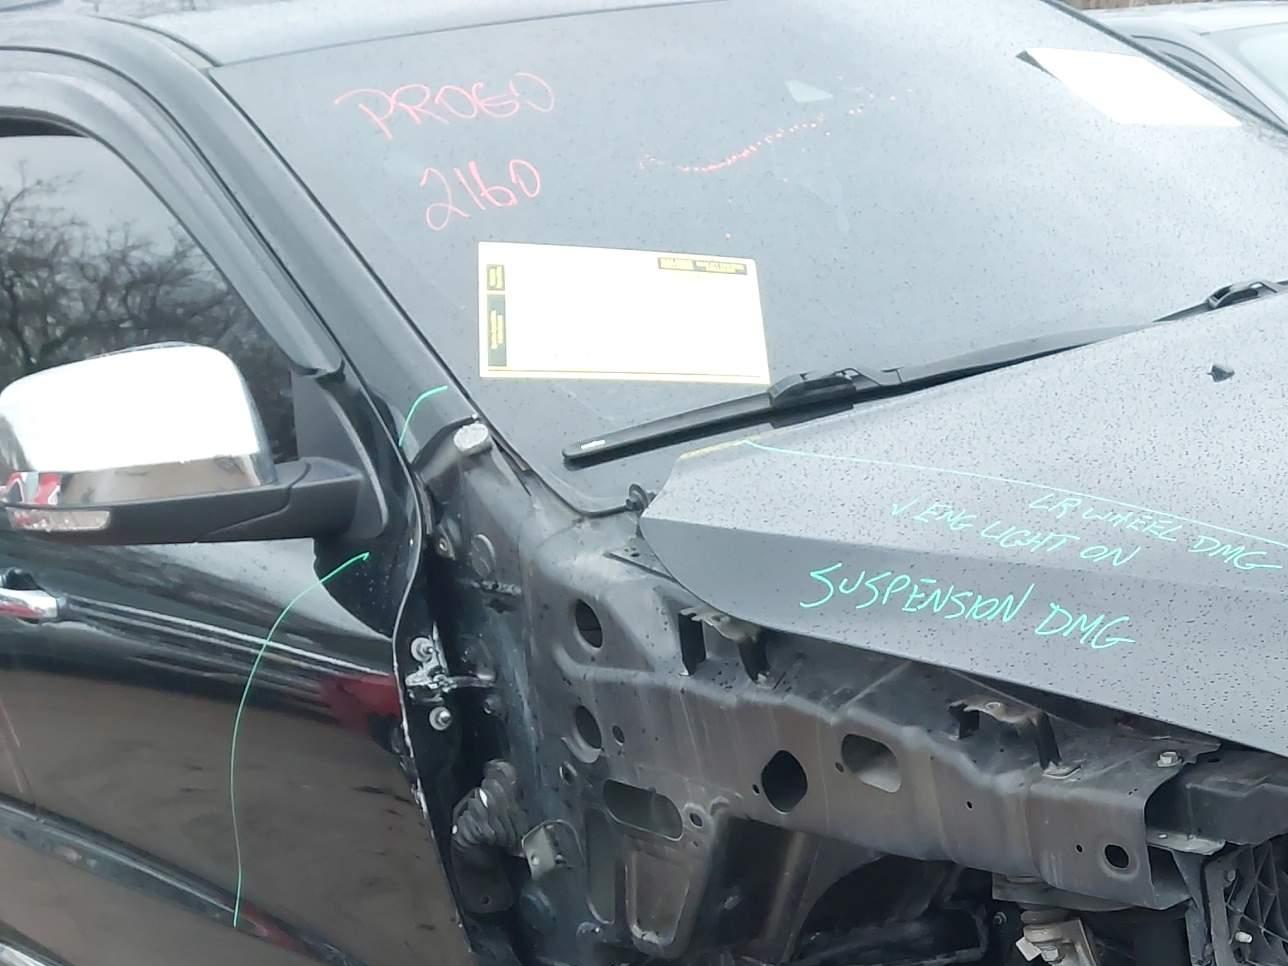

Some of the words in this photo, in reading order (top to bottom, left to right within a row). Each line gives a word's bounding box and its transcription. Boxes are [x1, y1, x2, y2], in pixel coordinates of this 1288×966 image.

[419, 159, 541, 231] 2160
[914, 502, 976, 532] ENG
[980, 520, 1081, 553] LIGHT
[1079, 545, 1141, 568] ON
[1028, 493, 1083, 519] LR
[1082, 507, 1178, 542] WHEEL
[1188, 535, 1283, 571] DMG
[800, 562, 1035, 622] SUSPENSION
[1034, 602, 1137, 649] DMG
